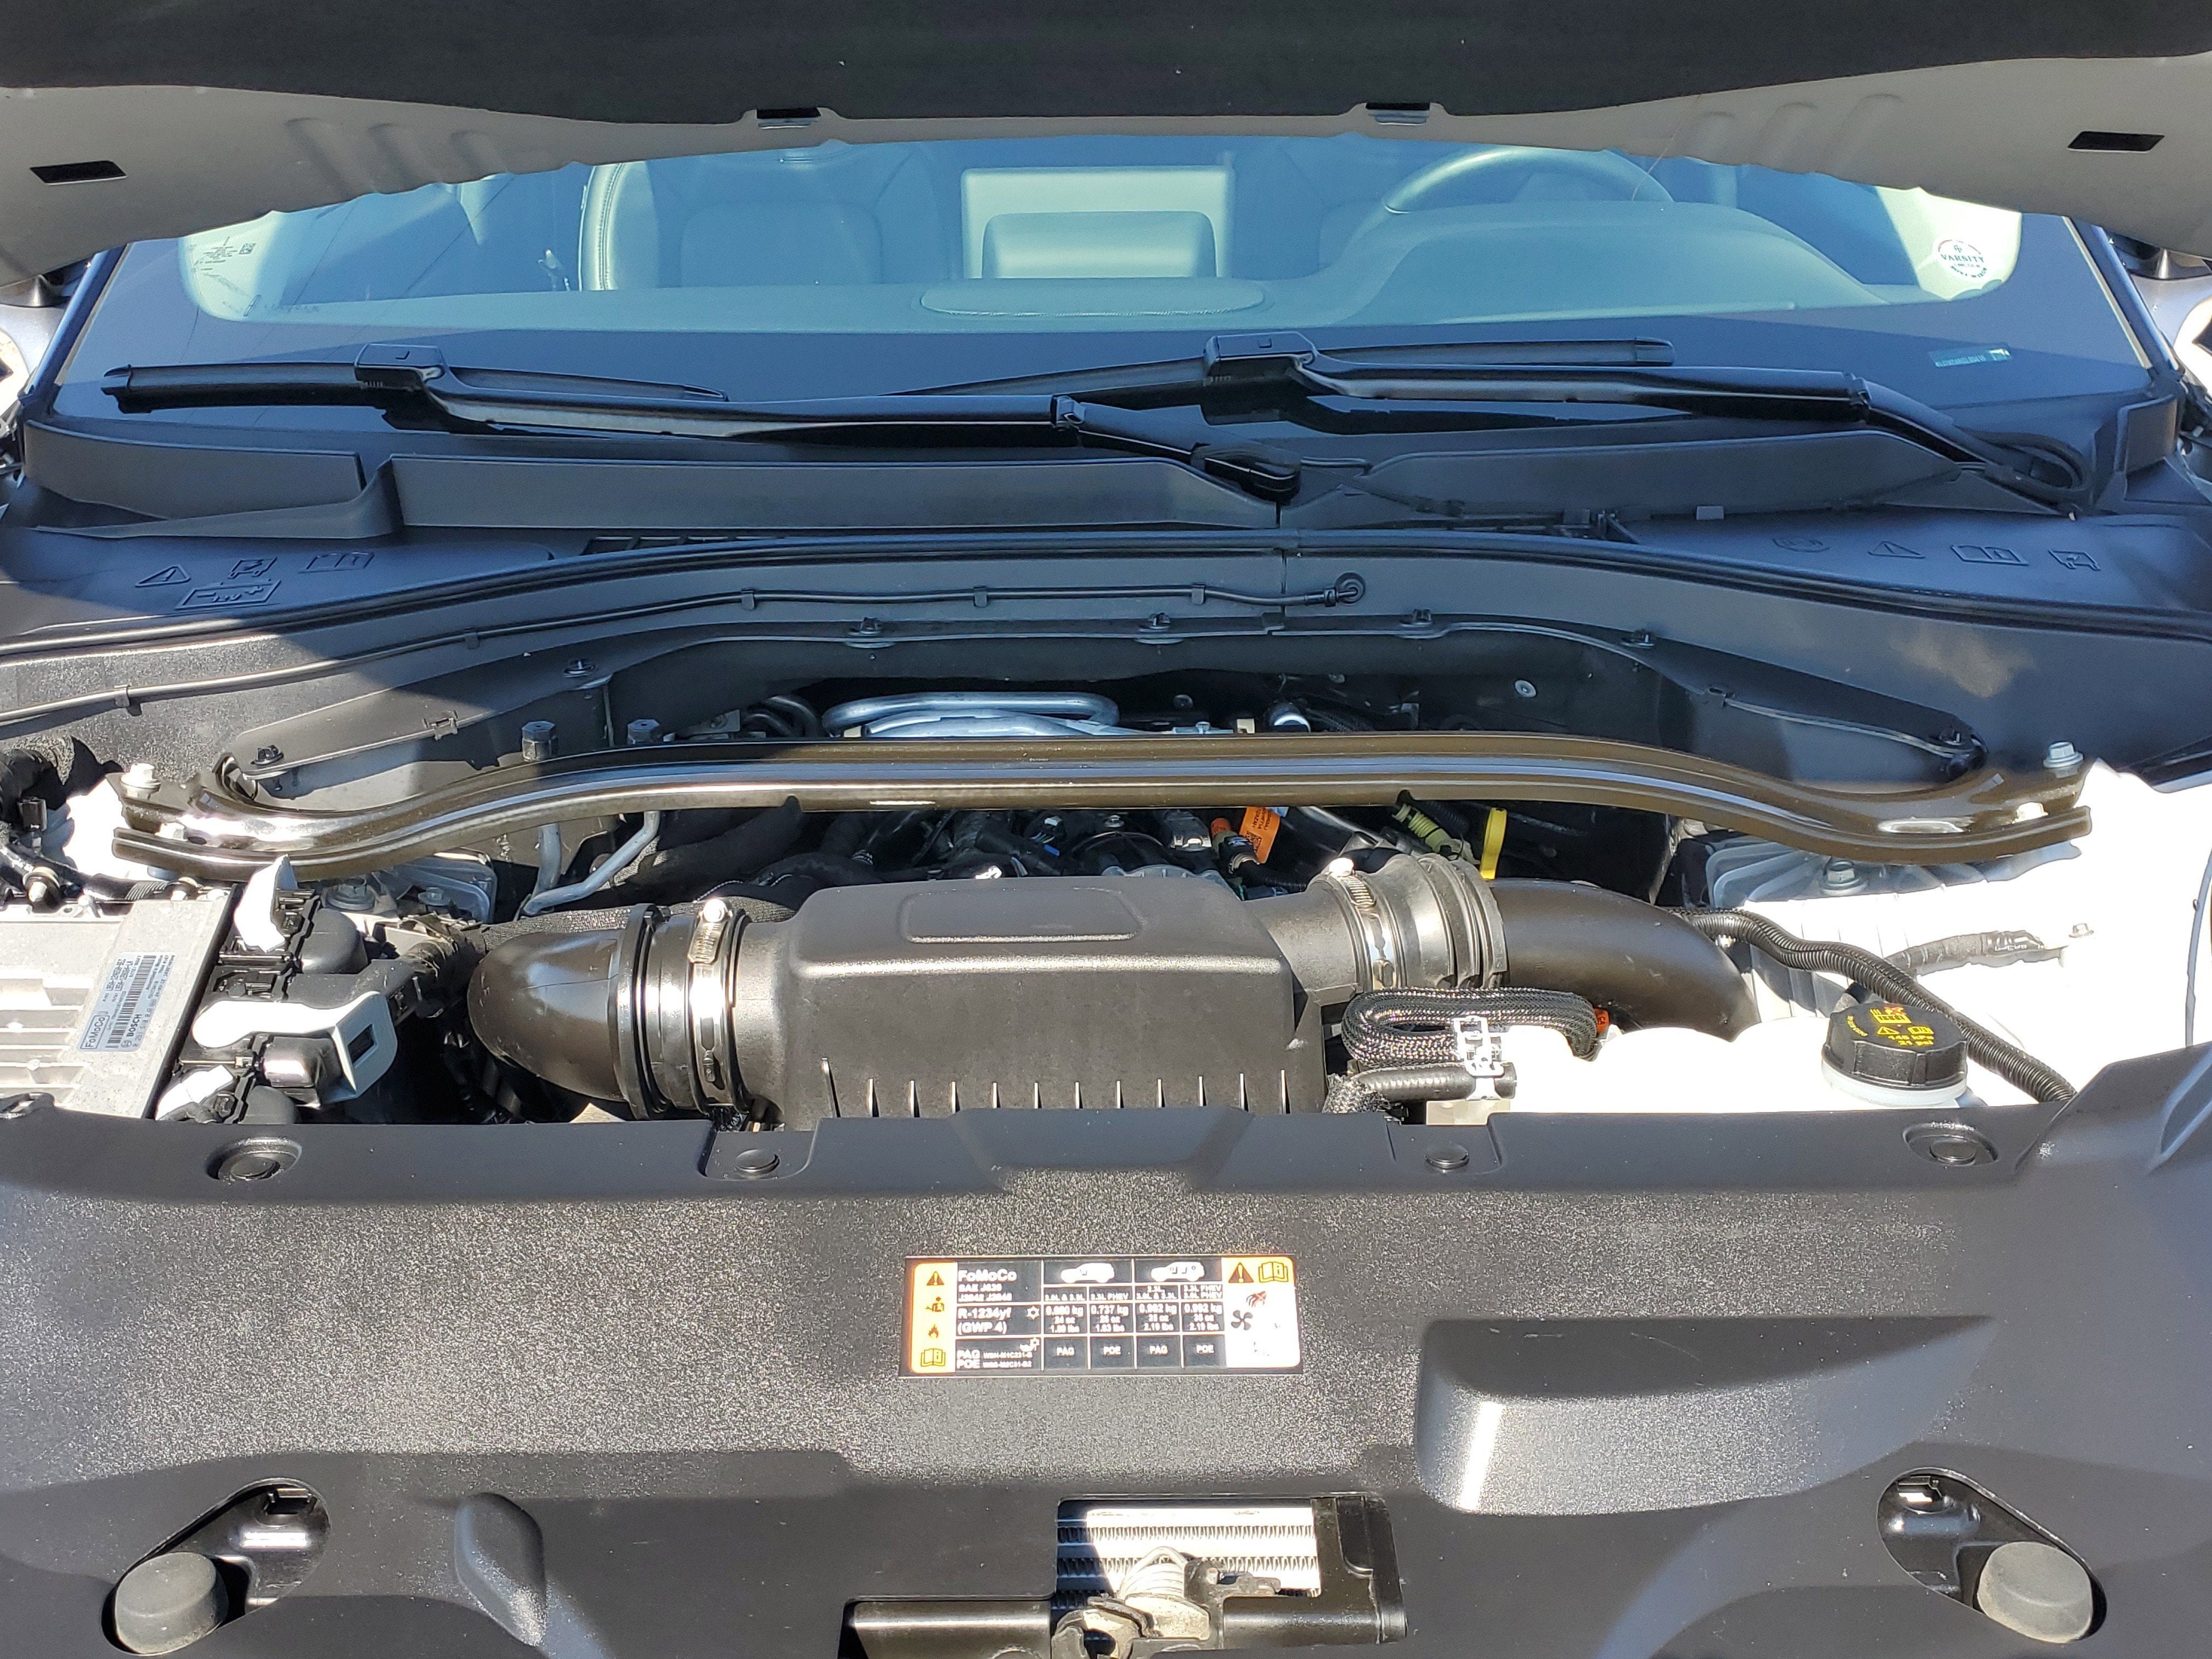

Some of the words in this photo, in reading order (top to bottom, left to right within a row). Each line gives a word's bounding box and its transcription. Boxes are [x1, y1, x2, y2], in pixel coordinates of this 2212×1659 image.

[1940, 254, 1984, 263] VARSITY
[126, 1014, 140, 1037] BOSCH
[85, 1016, 105, 1048] FoMoCo
[958, 1268, 1017, 1282] FoMoCo
[1071, 1305, 1084, 1317] kg
[1091, 1305, 1115, 1314] 0.737
[1117, 1305, 1128, 1316] kg
[1165, 1303, 1177, 1314] kg
[1210, 1302, 1222, 1314] kg
[958, 1307, 1012, 1320] R-1234yf
[957, 1322, 992, 1335] (GWP
[994, 1321, 1007, 1334] 4)
[1068, 1324, 1080, 1333] lbs
[1113, 1324, 1125, 1332] lbs
[1161, 1322, 1174, 1331] lbs
[1206, 1322, 1219, 1330] lbs
[1057, 1347, 1075, 1356] PAG
[1103, 1346, 1121, 1355] POE
[1149, 1346, 1168, 1354] PAG
[1197, 1345, 1214, 1353] POE
[957, 1349, 980, 1359] PAG
[956, 1359, 980, 1368] POE
